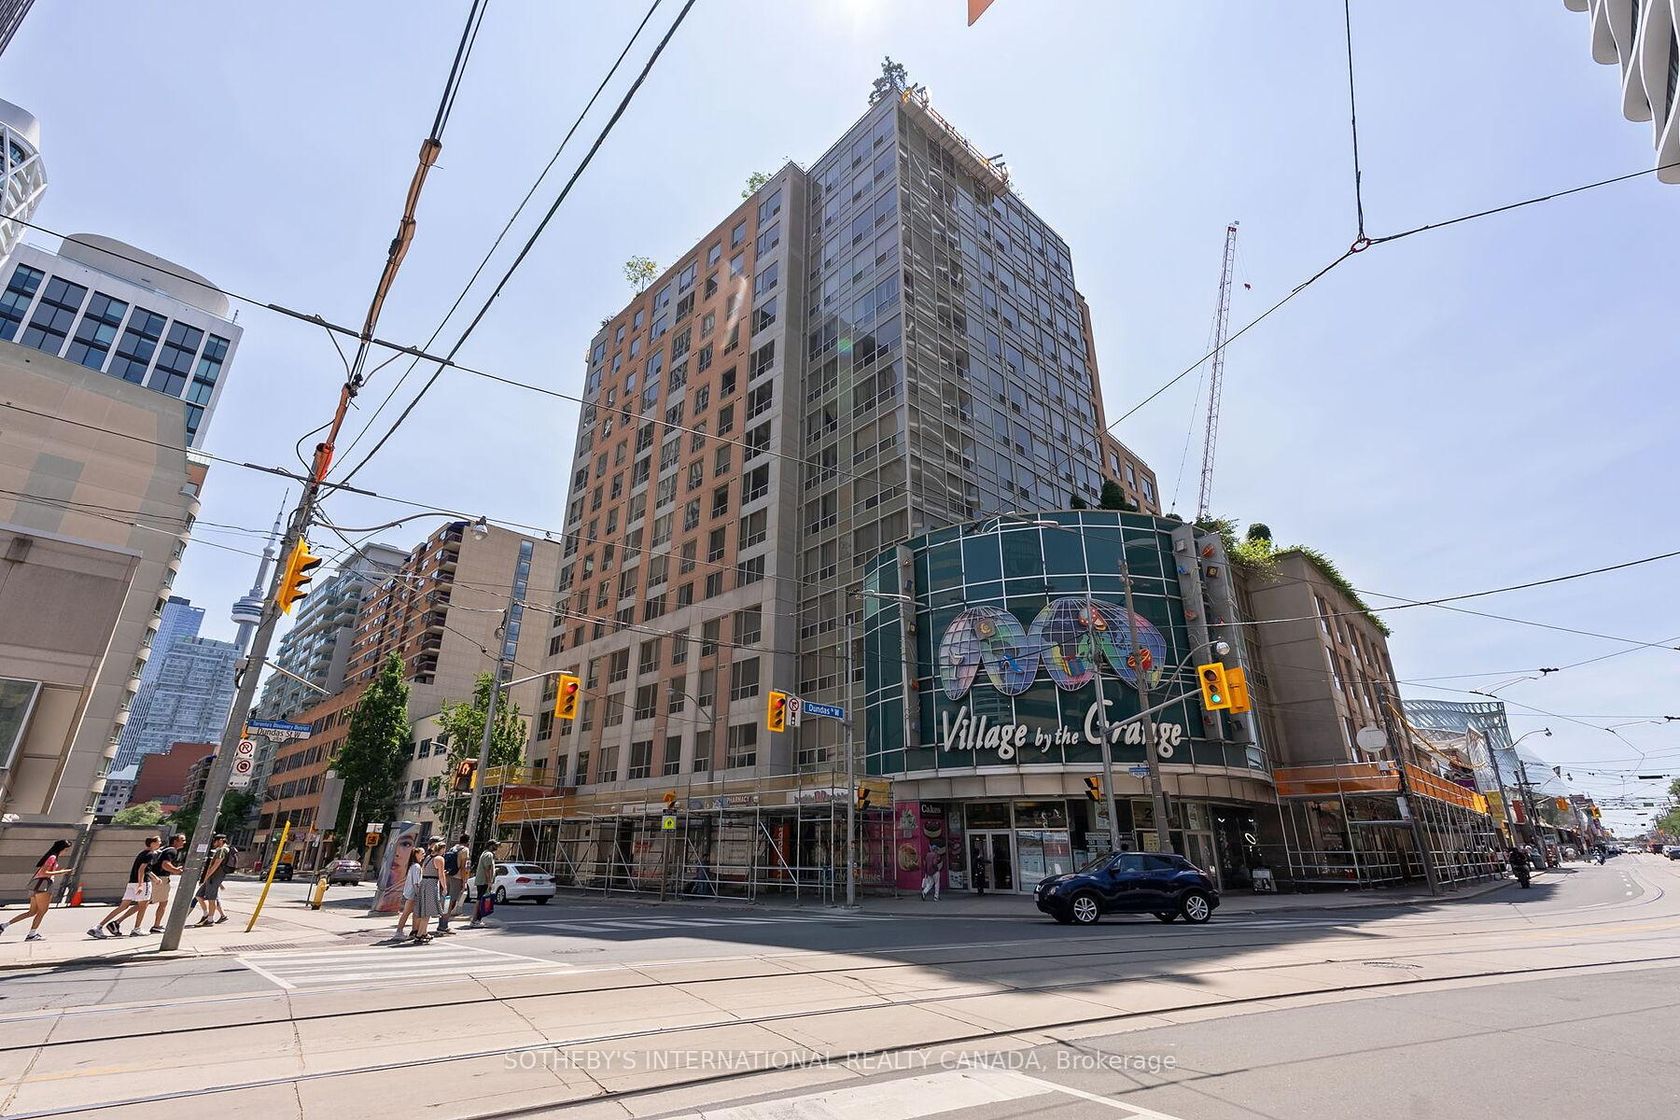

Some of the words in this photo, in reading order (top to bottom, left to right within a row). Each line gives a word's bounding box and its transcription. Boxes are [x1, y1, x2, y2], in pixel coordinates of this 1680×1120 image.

[808, 703, 830, 715] Dundas
[257, 728, 284, 737] Dundas
[942, 705, 1027, 759] Village
[1034, 726, 1052, 753] by
[1055, 725, 1079, 745] the
[921, 804, 941, 814] Cakes
